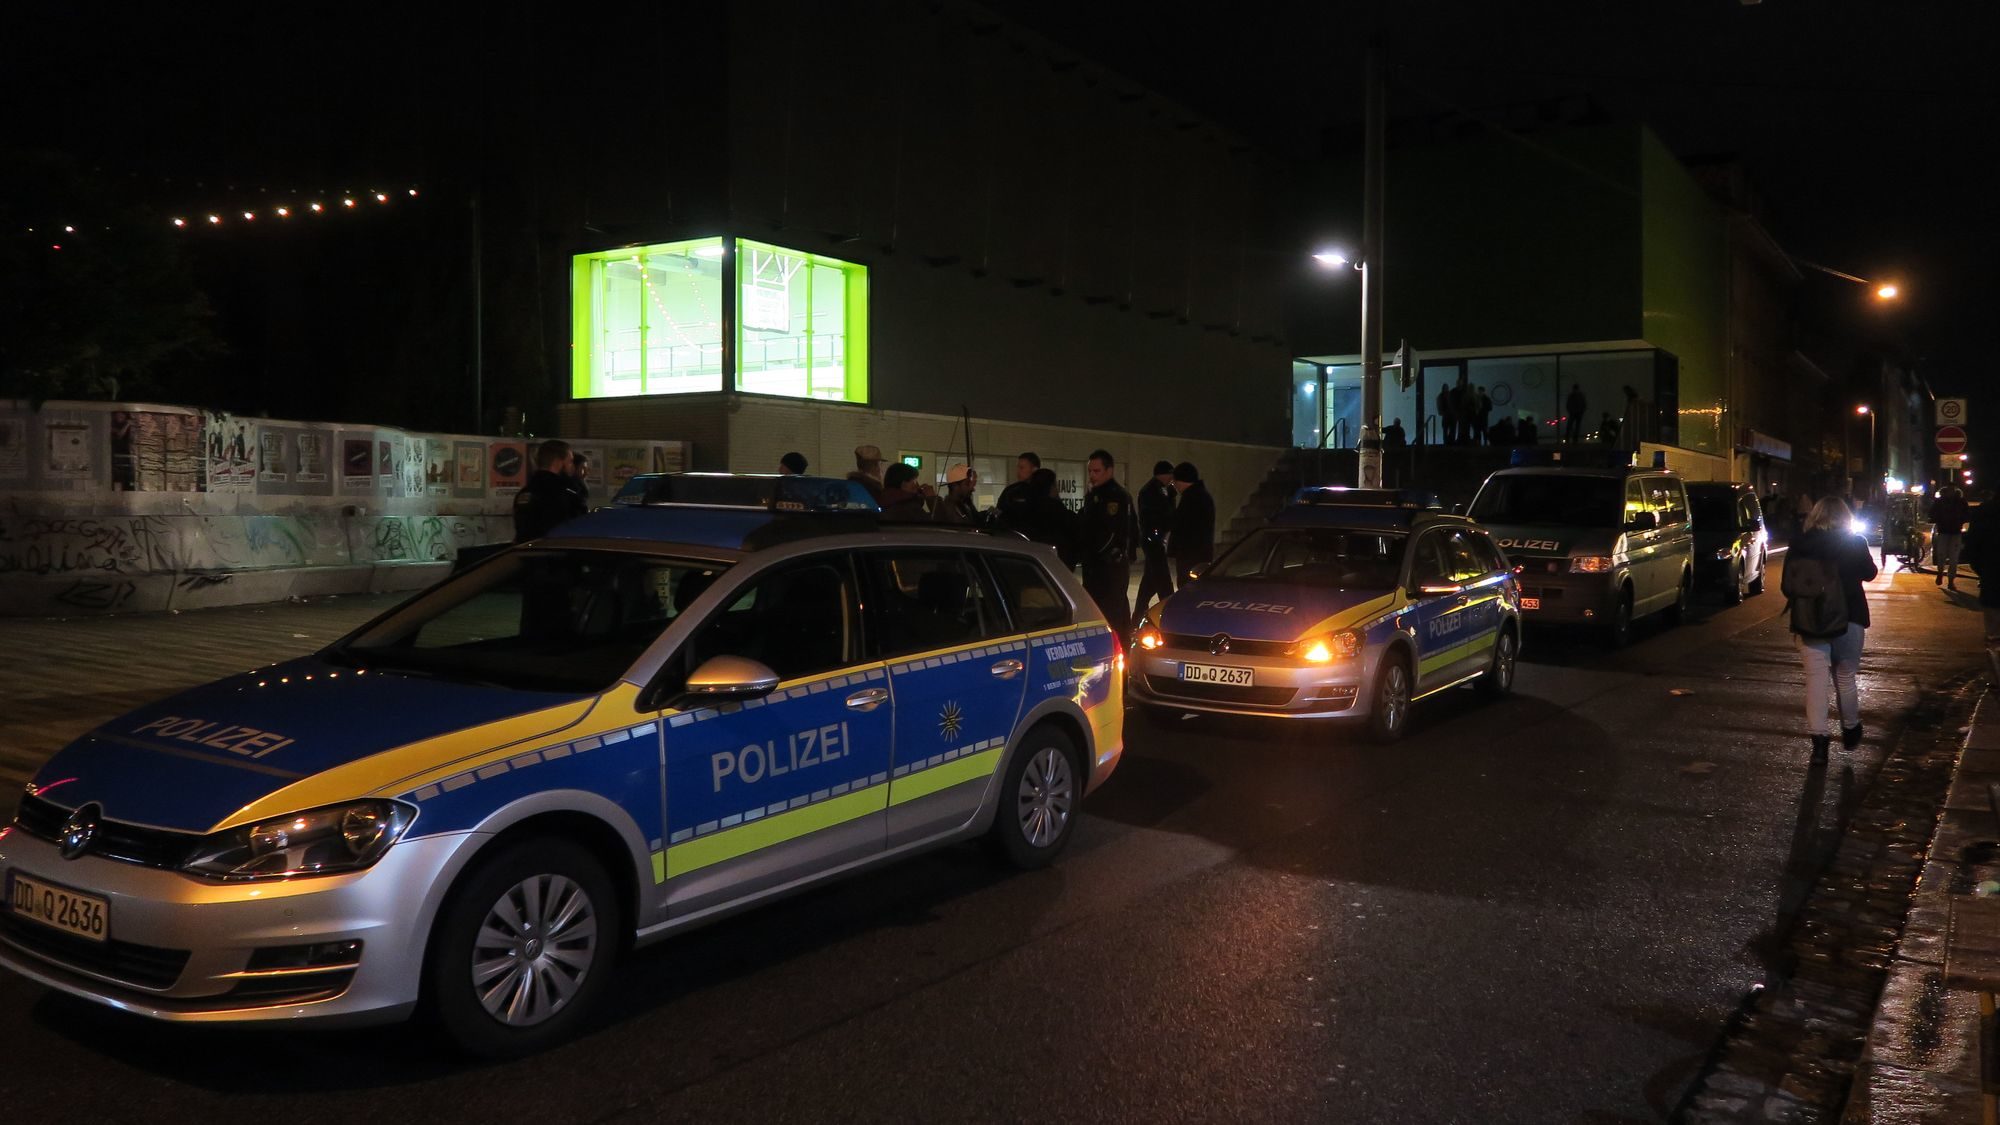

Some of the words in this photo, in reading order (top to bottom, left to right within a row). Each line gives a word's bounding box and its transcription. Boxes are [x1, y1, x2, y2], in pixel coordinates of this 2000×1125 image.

[1497, 538, 1560, 551] OLIZEI
[1196, 600, 1295, 615] POLIZEI
[1520, 599, 1538, 609] 453
[1429, 612, 1462, 640] POLIZEI
[1186, 666, 1200, 680] DD
[1209, 668, 1217, 681] Q
[1220, 669, 1252, 684] 2637
[129, 715, 297, 759] POLIZEI
[711, 721, 850, 793] POLIZEI
[16, 879, 34, 912] DD
[44, 889, 54, 921] Q
[58, 894, 103, 934] 2636
